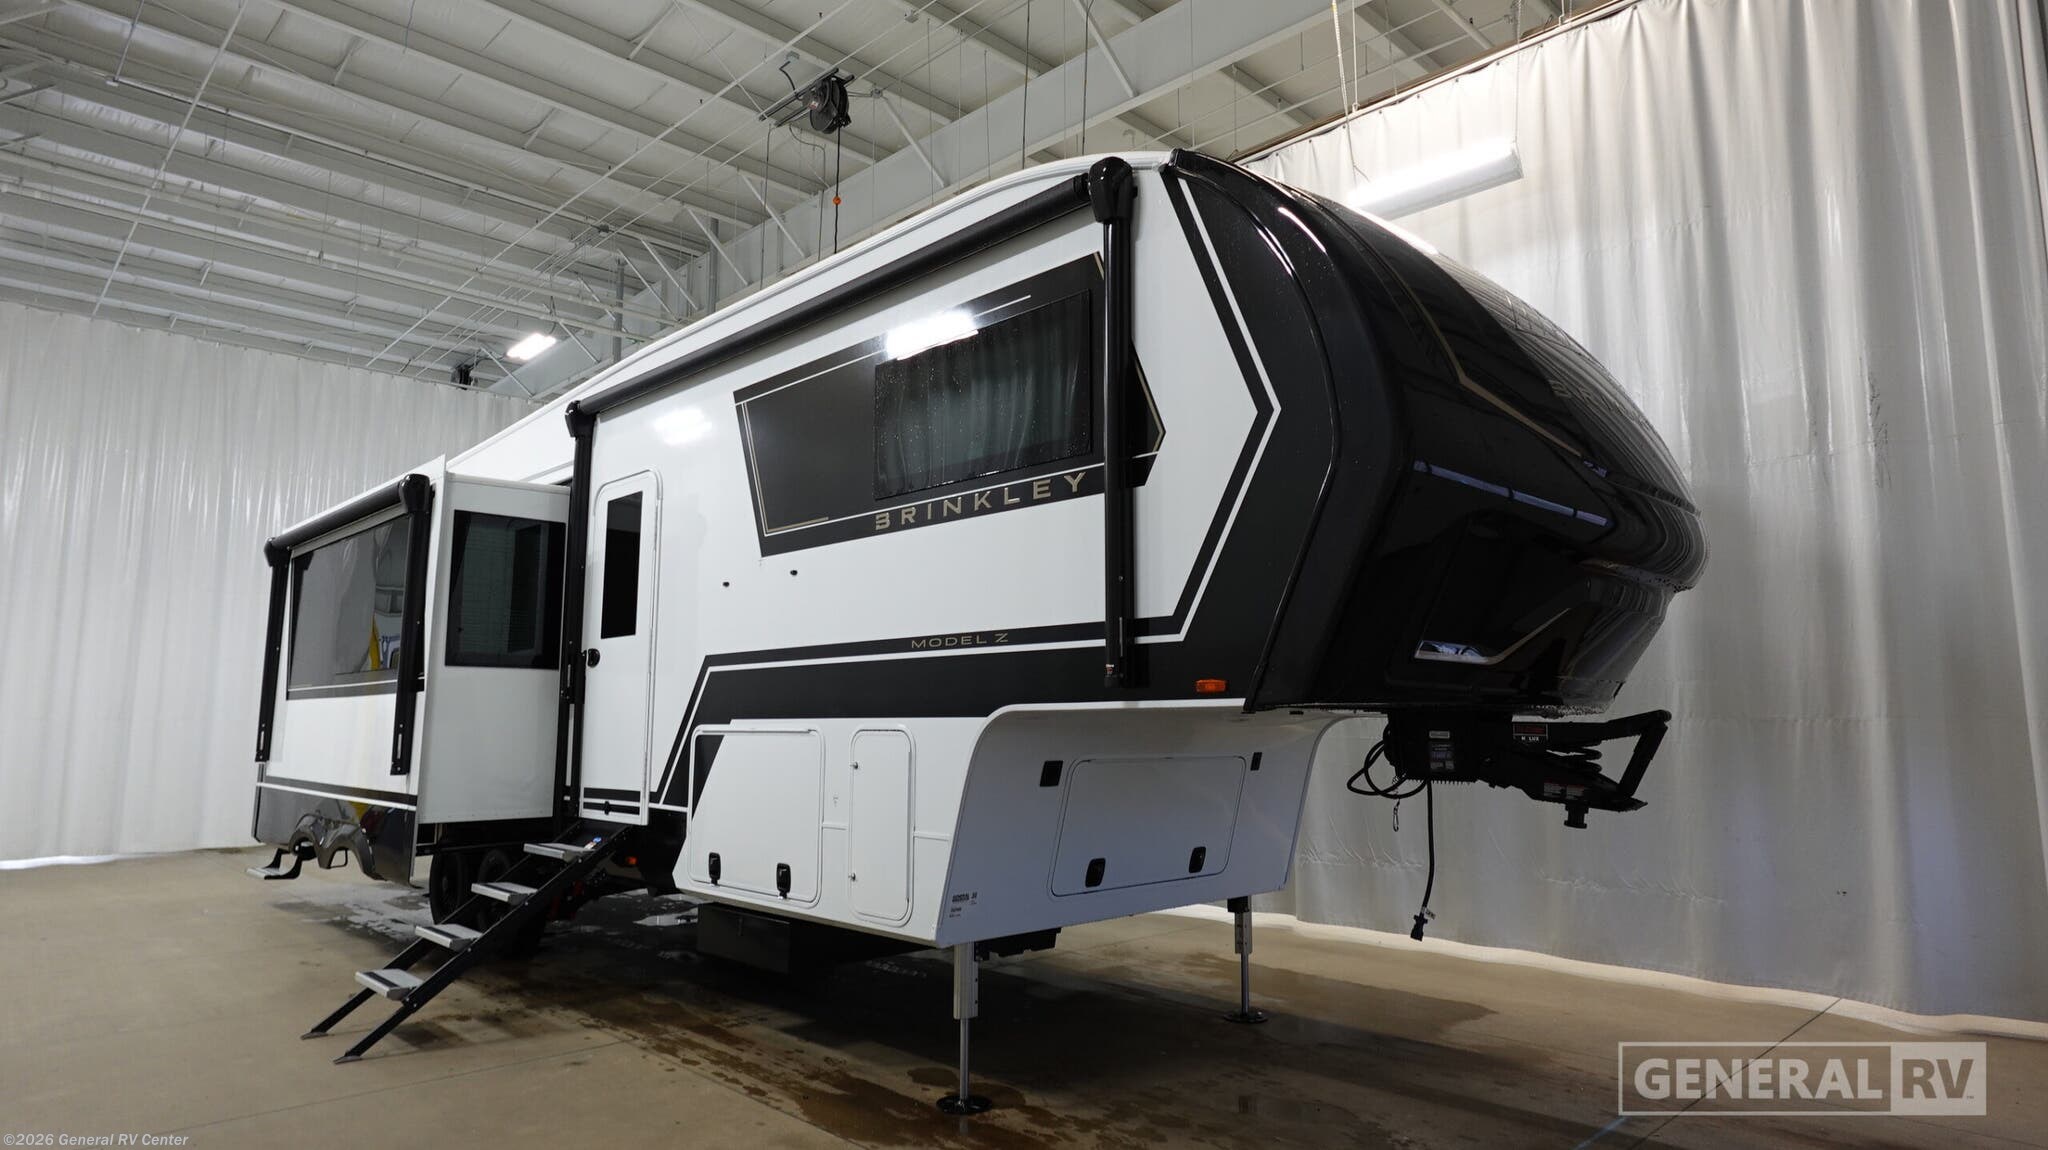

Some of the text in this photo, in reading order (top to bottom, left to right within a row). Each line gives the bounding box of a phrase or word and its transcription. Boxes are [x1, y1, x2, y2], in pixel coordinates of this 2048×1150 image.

[875, 472, 1086, 530] BRINKLEY
[911, 632, 1009, 649] MODEL Z
